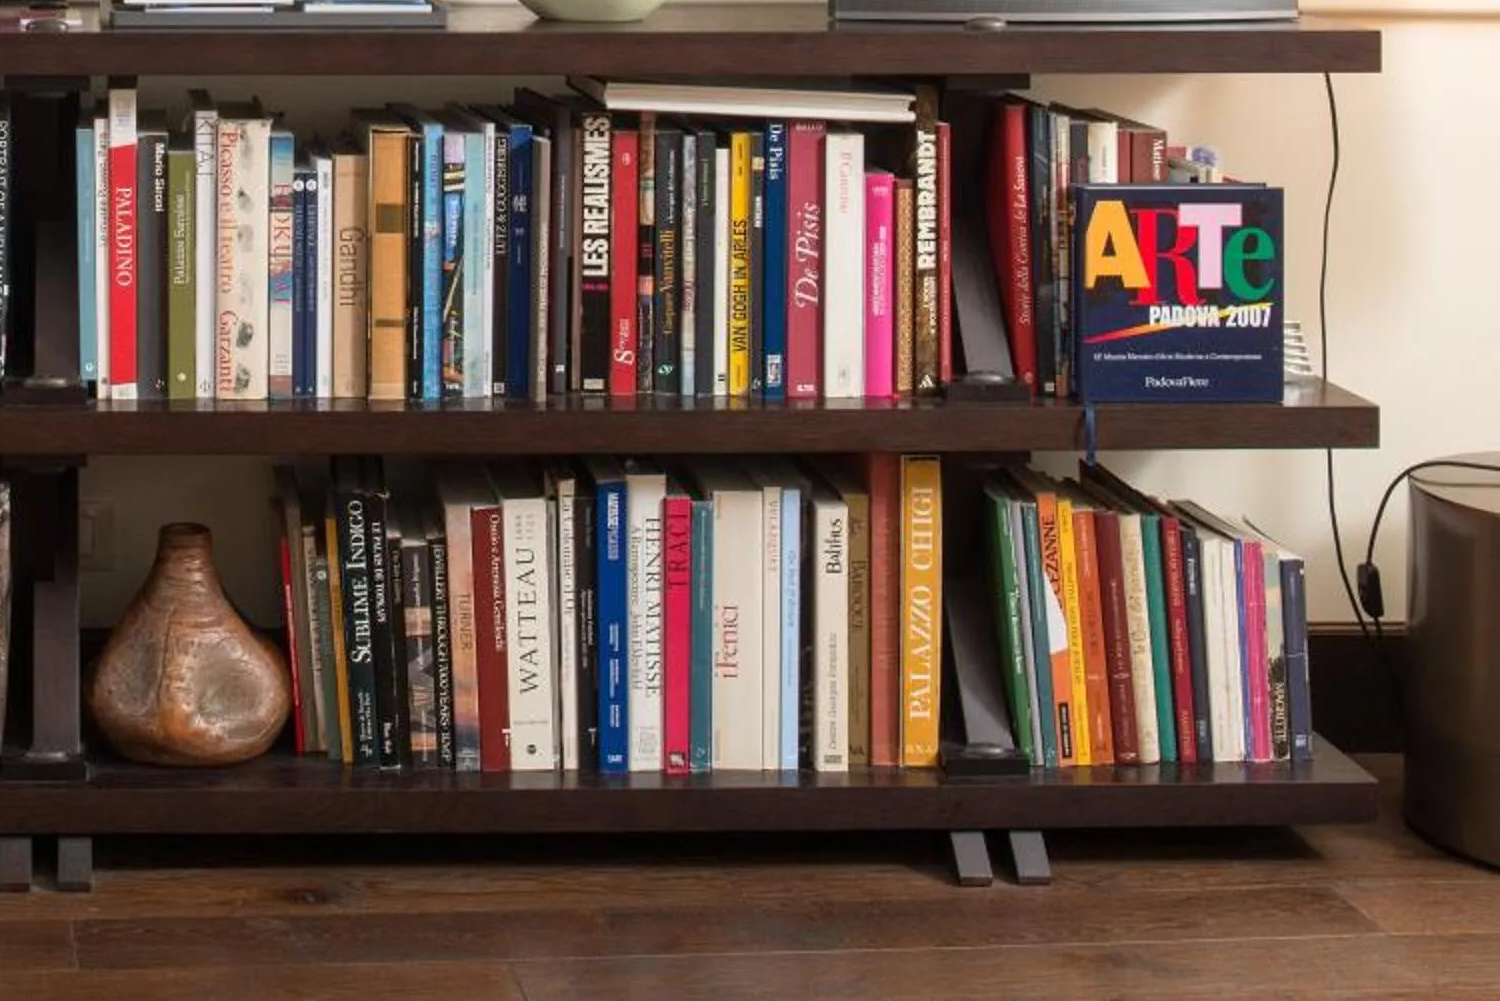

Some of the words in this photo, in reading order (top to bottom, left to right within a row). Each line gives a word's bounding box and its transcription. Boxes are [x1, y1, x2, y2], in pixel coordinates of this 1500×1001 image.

[154, 143, 164, 175] Mario
[220, 130, 239, 196] Picasso
[769, 123, 782, 147] De
[769, 151, 782, 180] Pisis
[154, 178, 164, 212] Sironi
[583, 117, 609, 234] REALISMES
[917, 130, 936, 269] REMBRANDT
[115, 186, 133, 286] PALADINO
[274, 183, 290, 306] HOKUSAI
[583, 239, 609, 276] LES
[733, 219, 747, 260] ARLES
[795, 202, 821, 262] Pisis
[339, 227, 364, 307] Gandhi
[733, 265, 747, 279] IN
[794, 267, 819, 308] De
[734, 286, 747, 321] GOGH
[1149, 305, 1220, 327] PADOVA
[1226, 305, 1271, 327] 2007
[219, 311, 238, 393] Garzanti
[734, 326, 748, 352] VAN
[345, 499, 367, 571] INDIGO
[645, 517, 663, 593] HENRI
[911, 486, 933, 571] CHIGI
[351, 577, 373, 663] SUBLIME
[458, 593, 471, 650] TURNER
[516, 547, 540, 693] WATTEAU
[645, 600, 661, 698] MATISSE
[909, 586, 933, 719] PALAZZO
